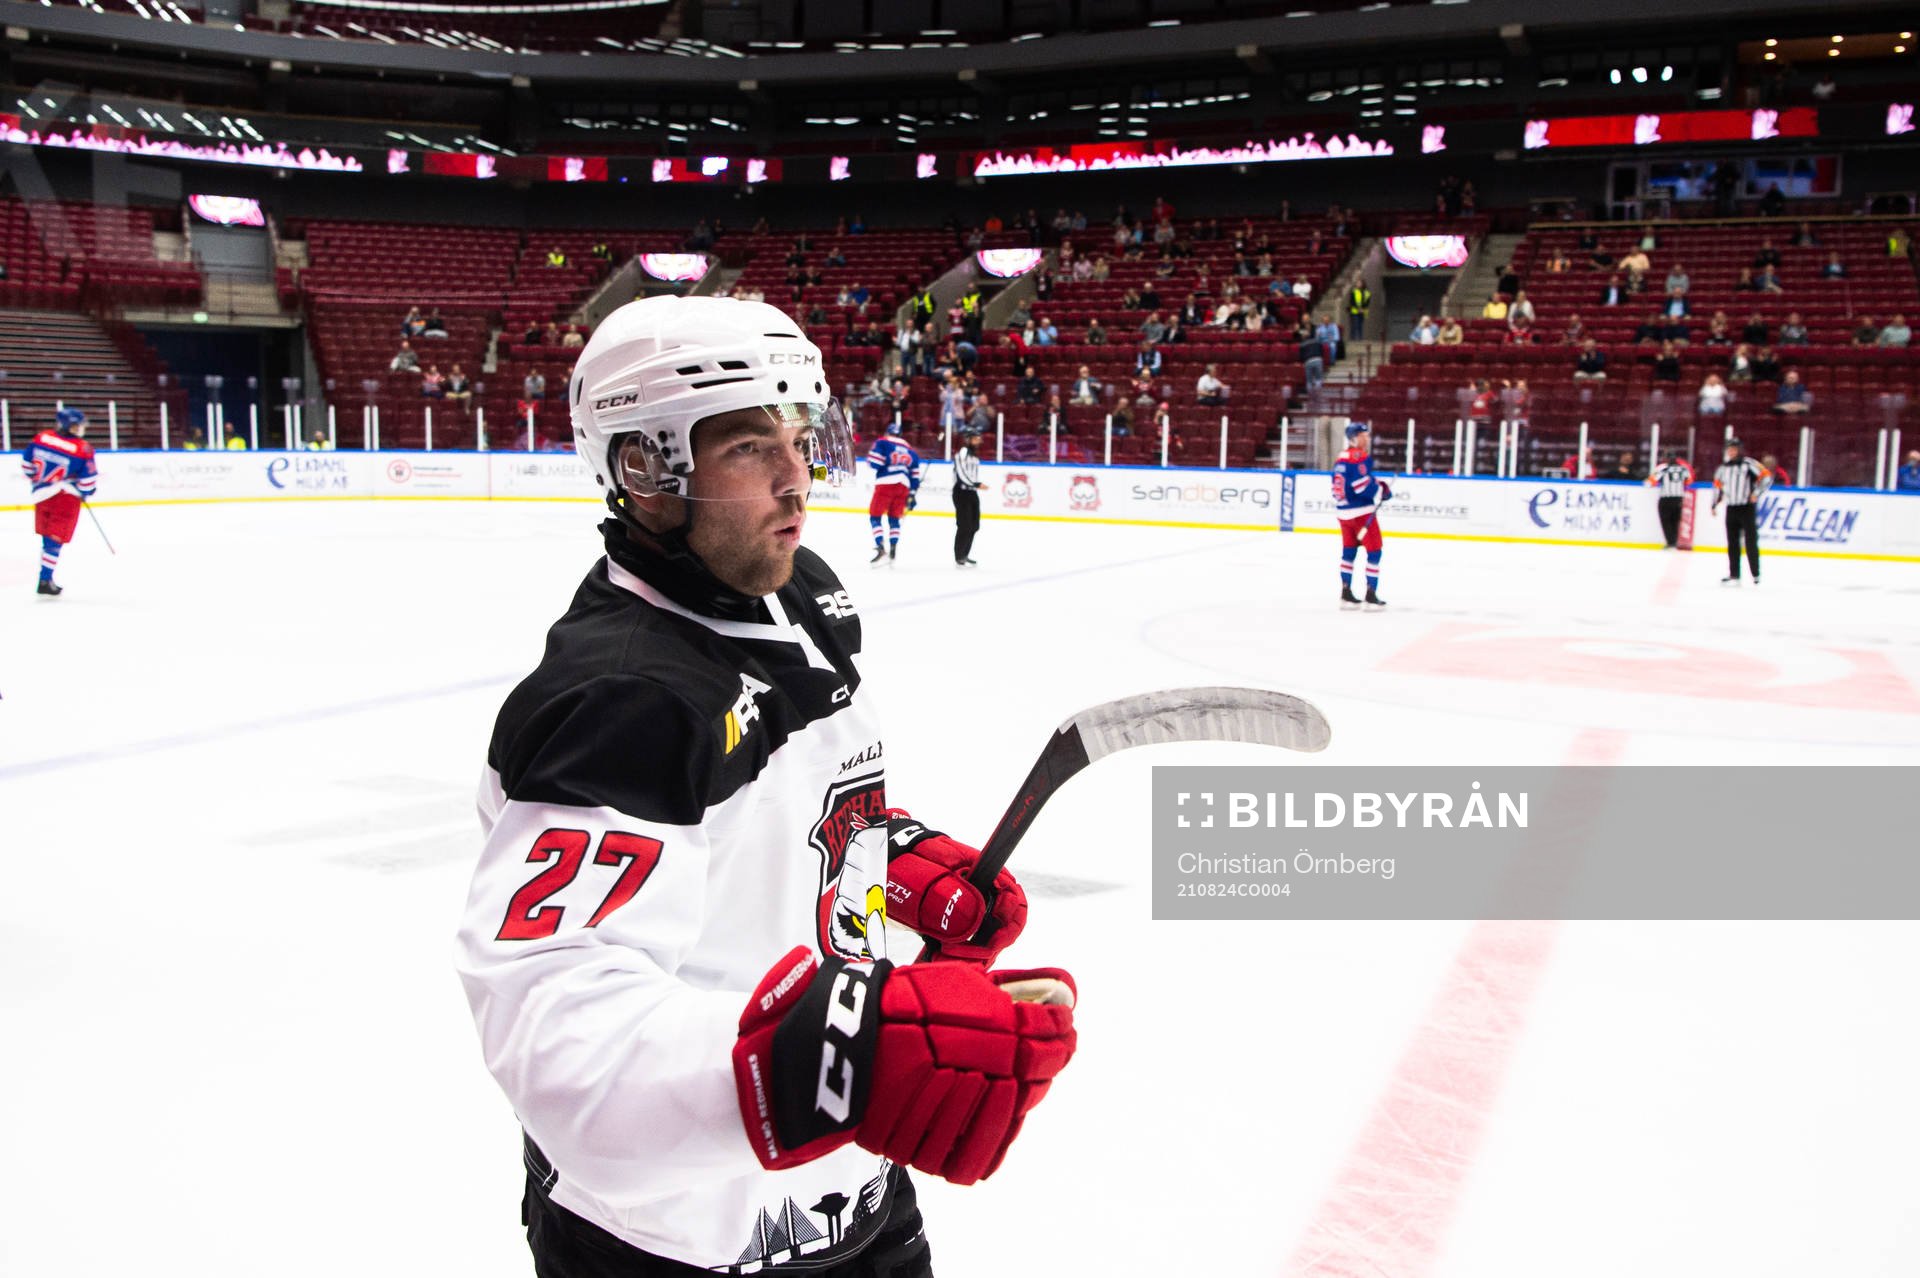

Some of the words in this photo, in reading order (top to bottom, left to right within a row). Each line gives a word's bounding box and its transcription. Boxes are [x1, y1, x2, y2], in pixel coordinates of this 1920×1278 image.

[769, 353, 816, 366] CCM
[595, 394, 639, 411] CCM
[1132, 484, 1270, 508] sandberg
[495, 828, 663, 941] 27
[887, 892, 904, 904] PRO
[941, 888, 963, 930] CCM
